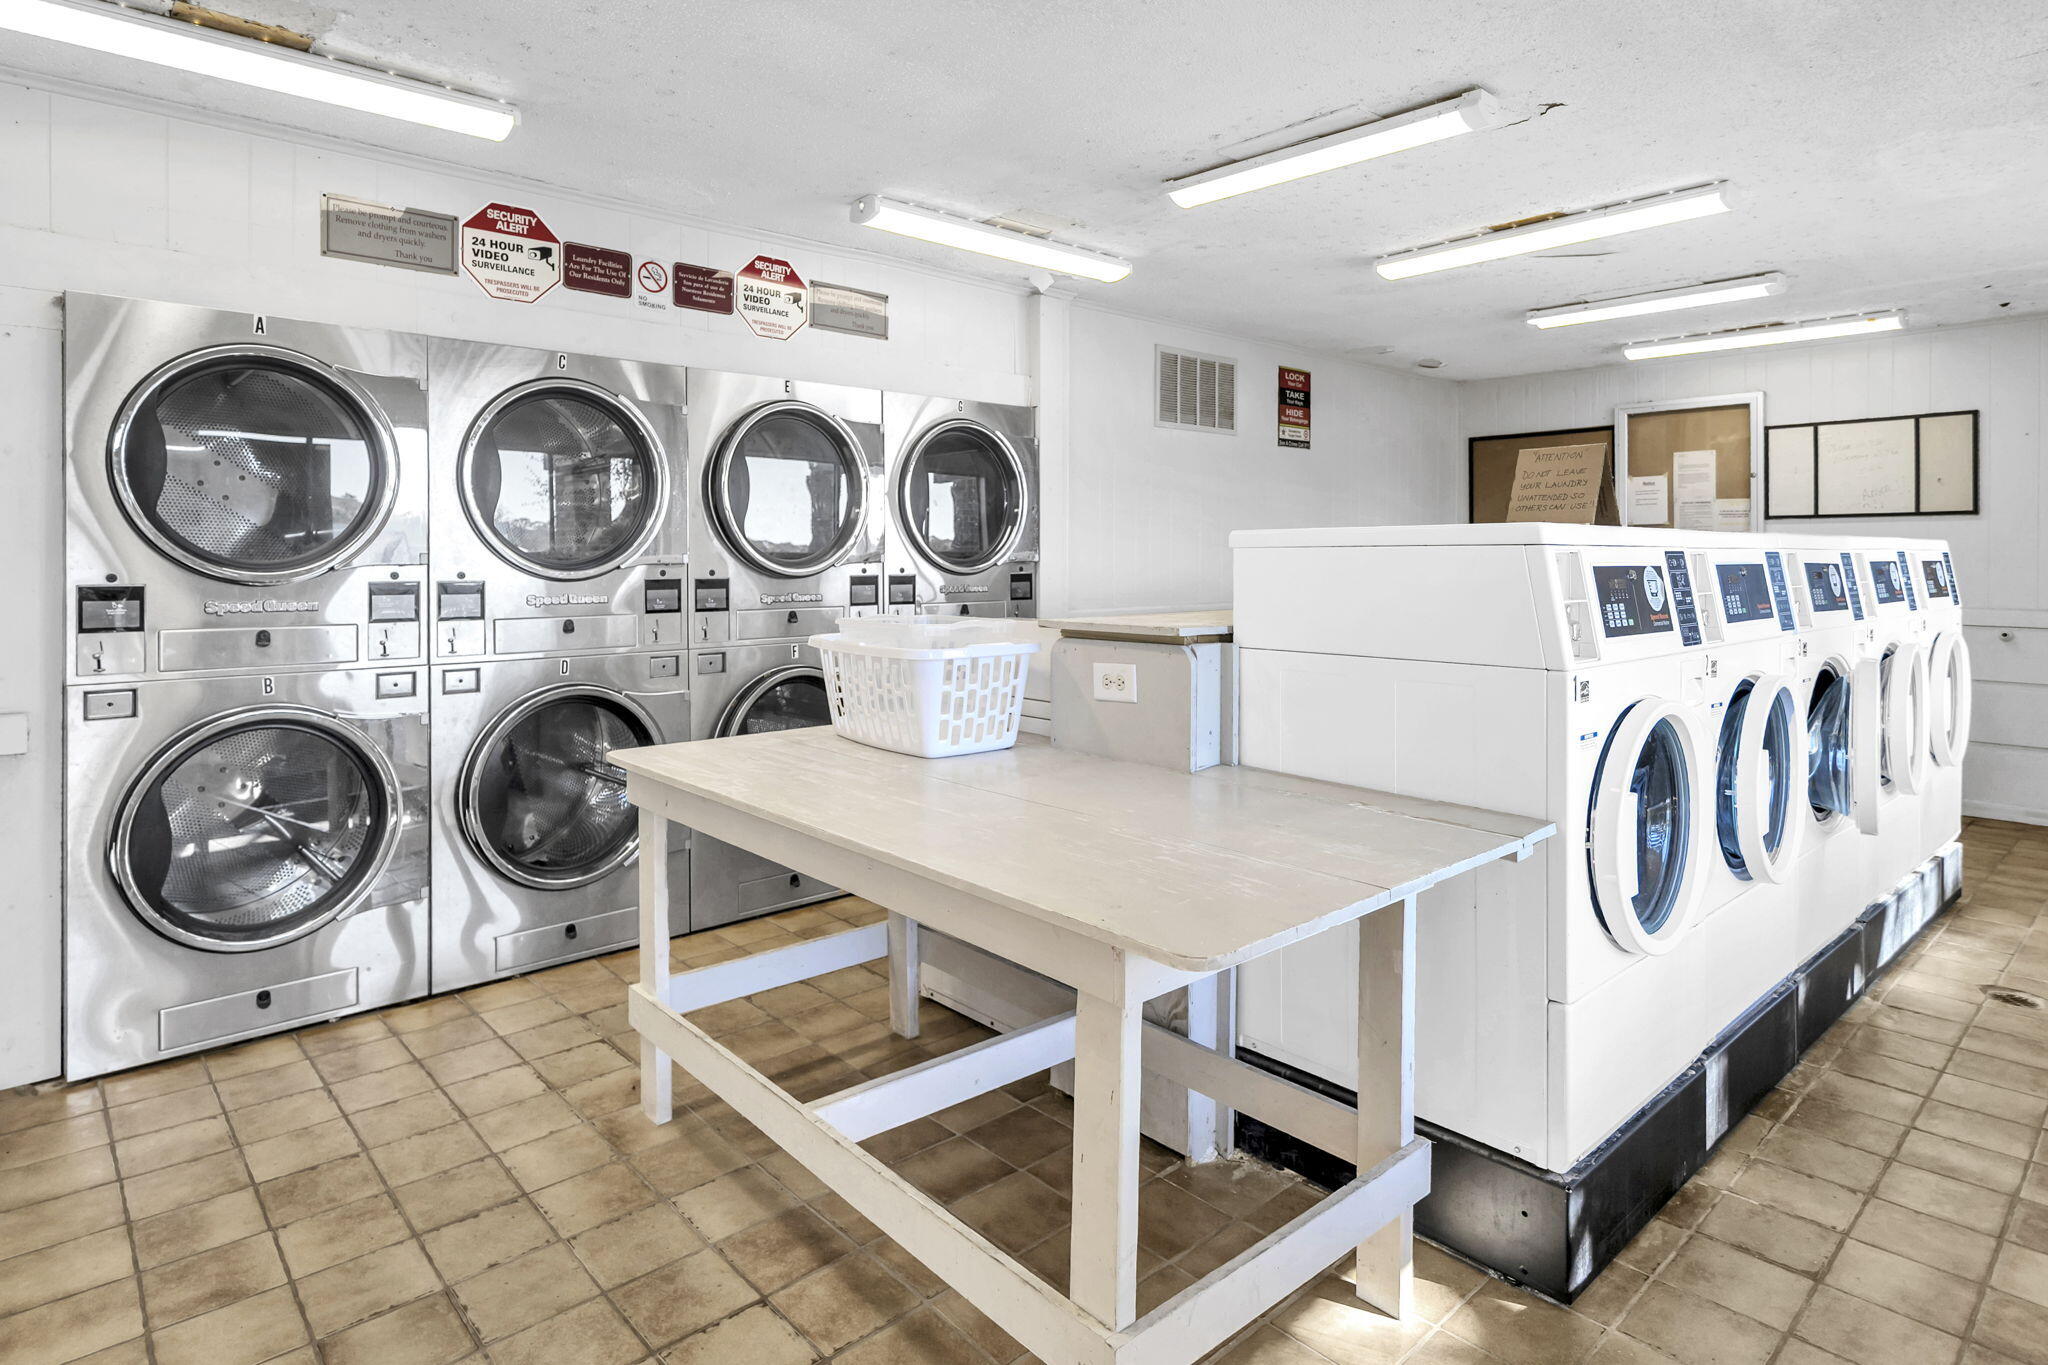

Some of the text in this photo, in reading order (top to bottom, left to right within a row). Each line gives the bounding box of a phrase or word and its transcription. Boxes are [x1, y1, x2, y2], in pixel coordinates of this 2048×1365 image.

[368, 211, 396, 224] prompt
[397, 216, 411, 224] and
[486, 208, 538, 227] SECURITY
[335, 214, 447, 241] Remove clothing from washers
[495, 220, 530, 235] ALERT
[357, 229, 372, 238] and
[373, 232, 398, 244] dryers
[471, 236, 524, 253] 24 HOUR
[395, 249, 433, 264] Thank you
[471, 248, 509, 262] VIDEO
[572, 254, 623, 269] Laundry Facilities
[471, 259, 536, 277] SURVEILLANCE
[568, 262, 627, 278] Are For The Use Of
[754, 260, 792, 276] SECURITY
[568, 270, 626, 287] Our Residents Only
[760, 270, 786, 282] ALERT
[484, 278, 520, 290] TRESPASSERS
[743, 283, 781, 298] 24 HOUR
[496, 287, 529, 297] PROSECUTED
[638, 300, 667, 310] SMOKING
[743, 293, 771, 306] VIDEO
[742, 303, 790, 318] SURVEILLANCE
[255, 316, 265, 334] A
[558, 354, 566, 369] C
[1284, 372, 1305, 382] LOCK
[785, 380, 790, 393] E
[1285, 390, 1305, 400] TAKE
[958, 400, 963, 412] G
[1285, 408, 1304, 418] HIDE
[1556, 467, 1591, 477] LEAVE
[1520, 479, 1588, 490] YOUR LAUNDRY
[1517, 492, 1586, 502] UNATTENDED SO
[1515, 504, 1548, 512] OTHERS
[204, 599, 319, 616] Speed Queen
[526, 593, 609, 608] Speed Queen
[792, 645, 797, 658] F
[561, 660, 568, 674] D
[264, 677, 273, 694] B
